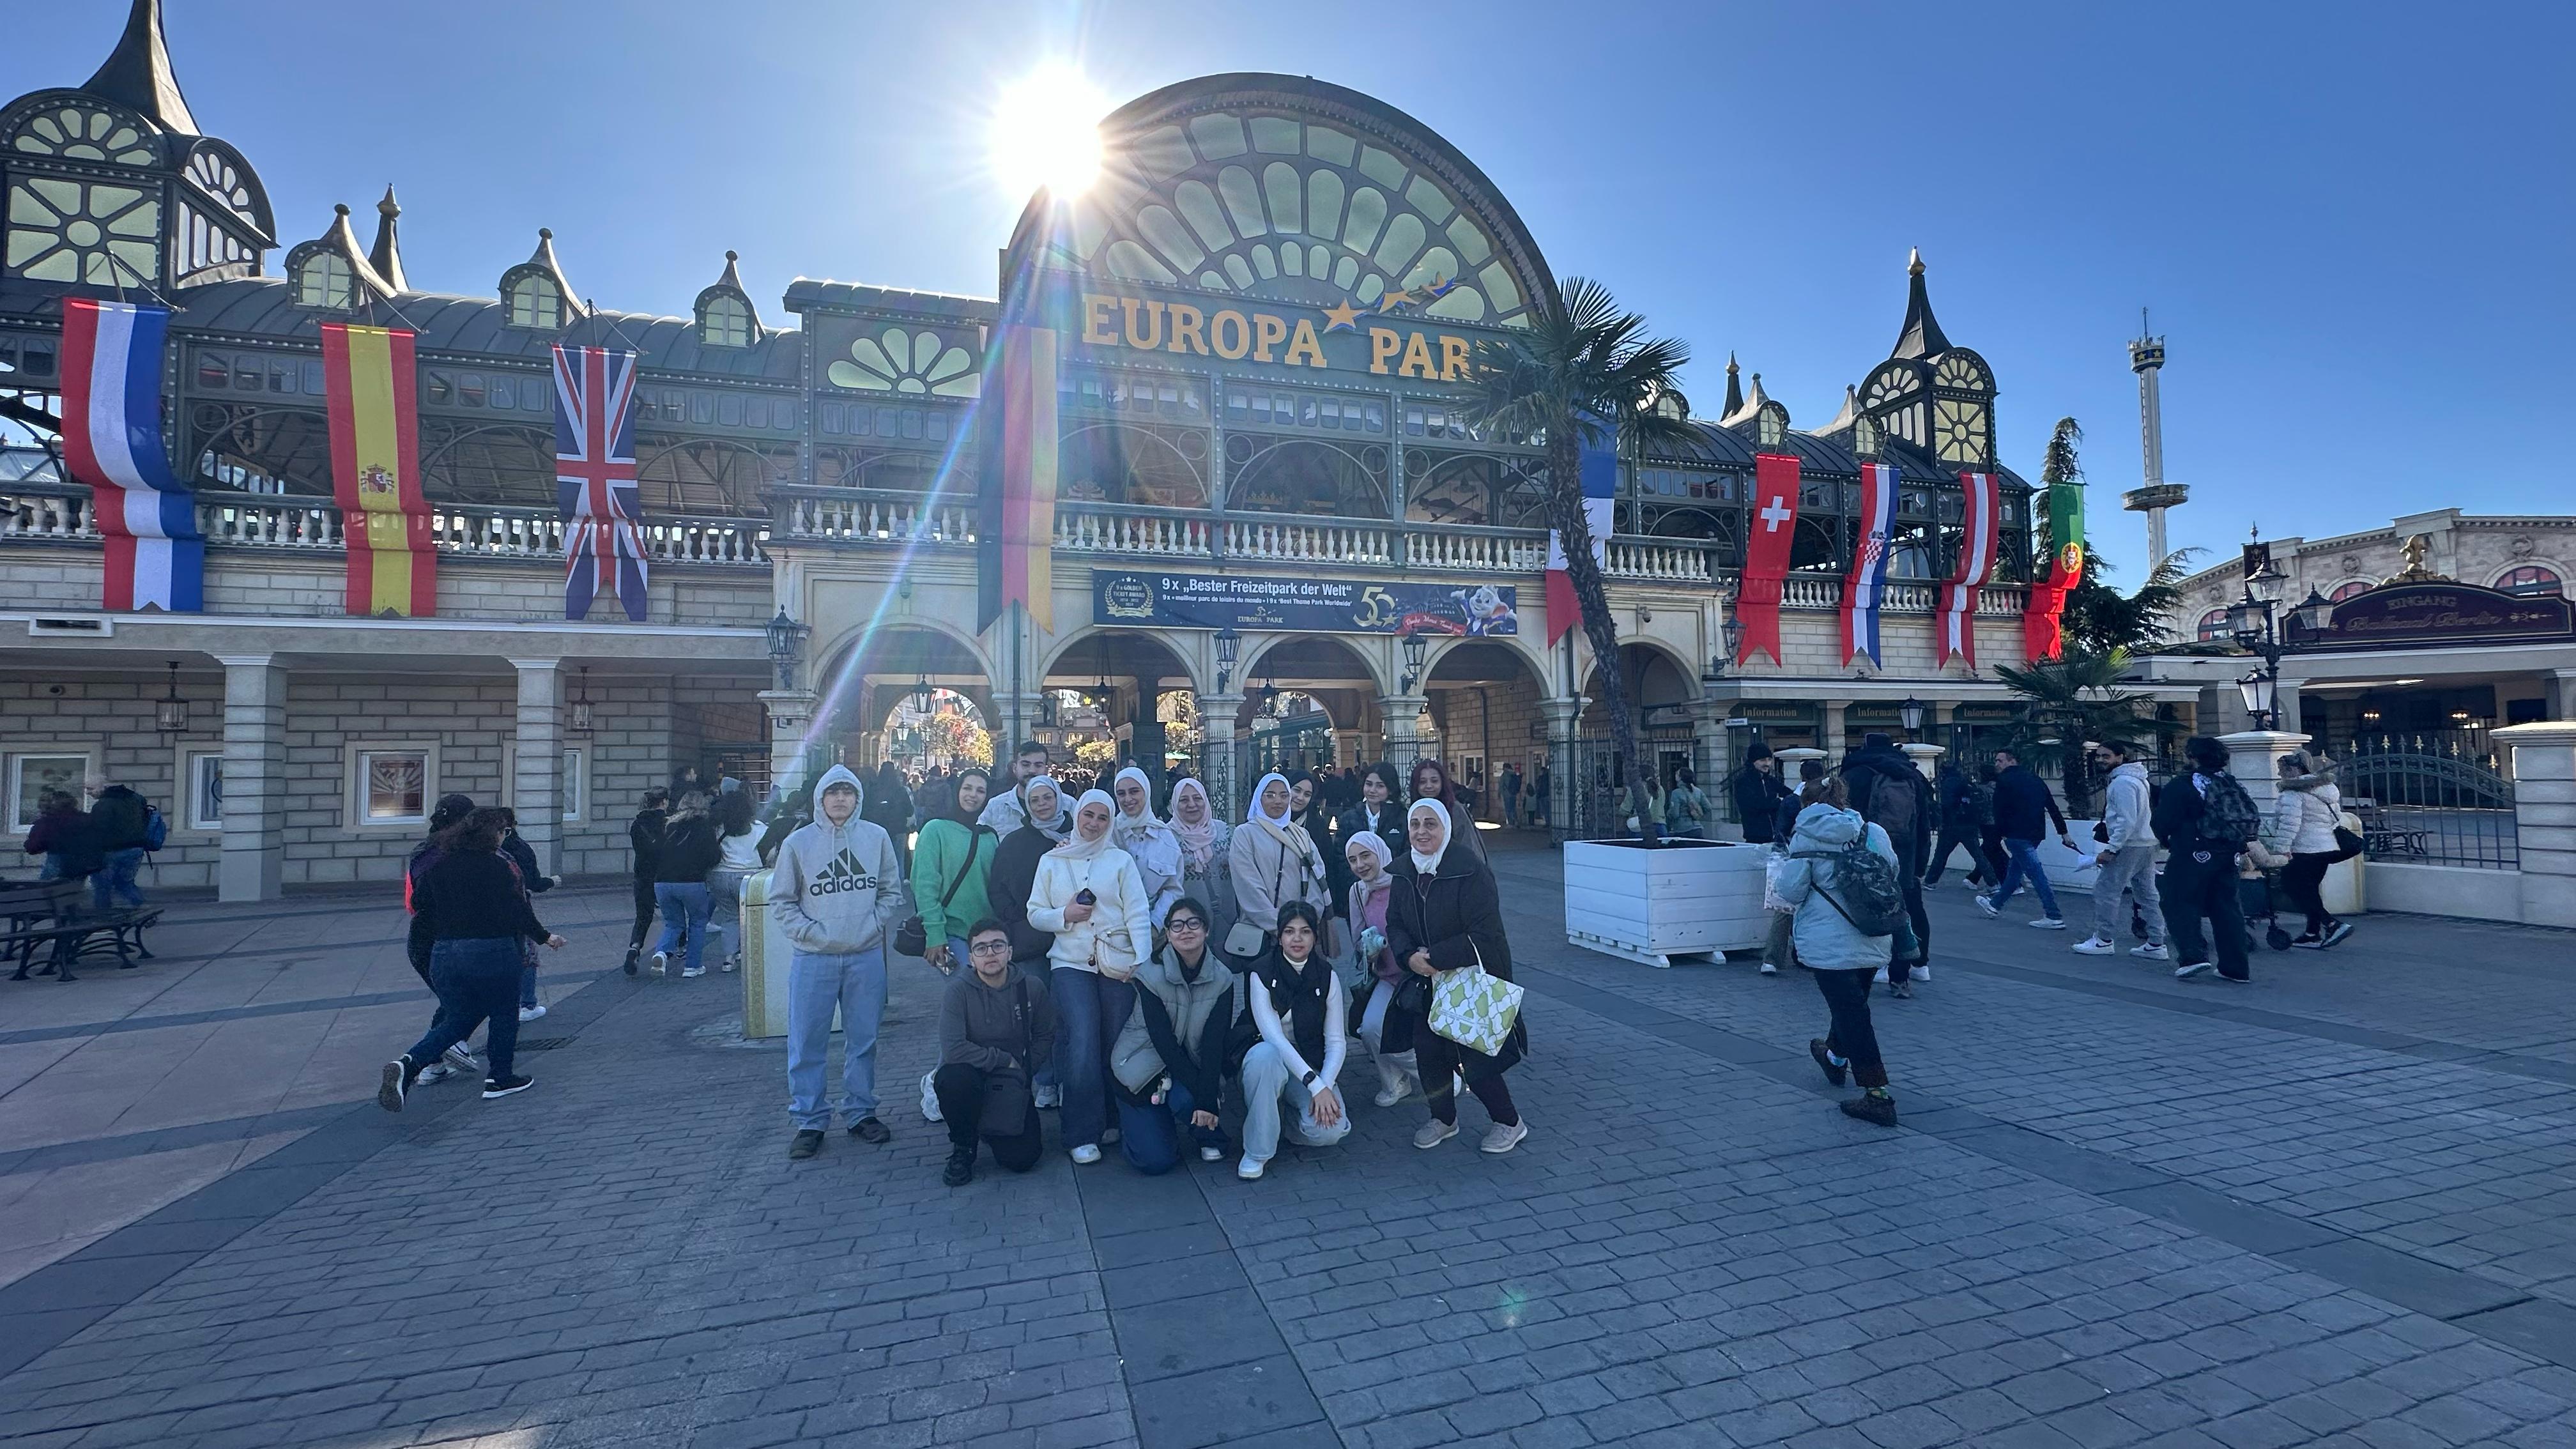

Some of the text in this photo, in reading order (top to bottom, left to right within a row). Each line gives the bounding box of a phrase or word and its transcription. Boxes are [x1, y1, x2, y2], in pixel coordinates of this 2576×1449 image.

[1082, 293, 1508, 384] EUROPA PAR
[1230, 580, 1298, 595] Freizeitpark
[1301, 583, 1319, 595] der
[2386, 595, 2457, 610] EINGANG
[1743, 707, 1797, 717] Information
[1964, 708, 2010, 717] Information
[809, 875, 877, 896] adidas
